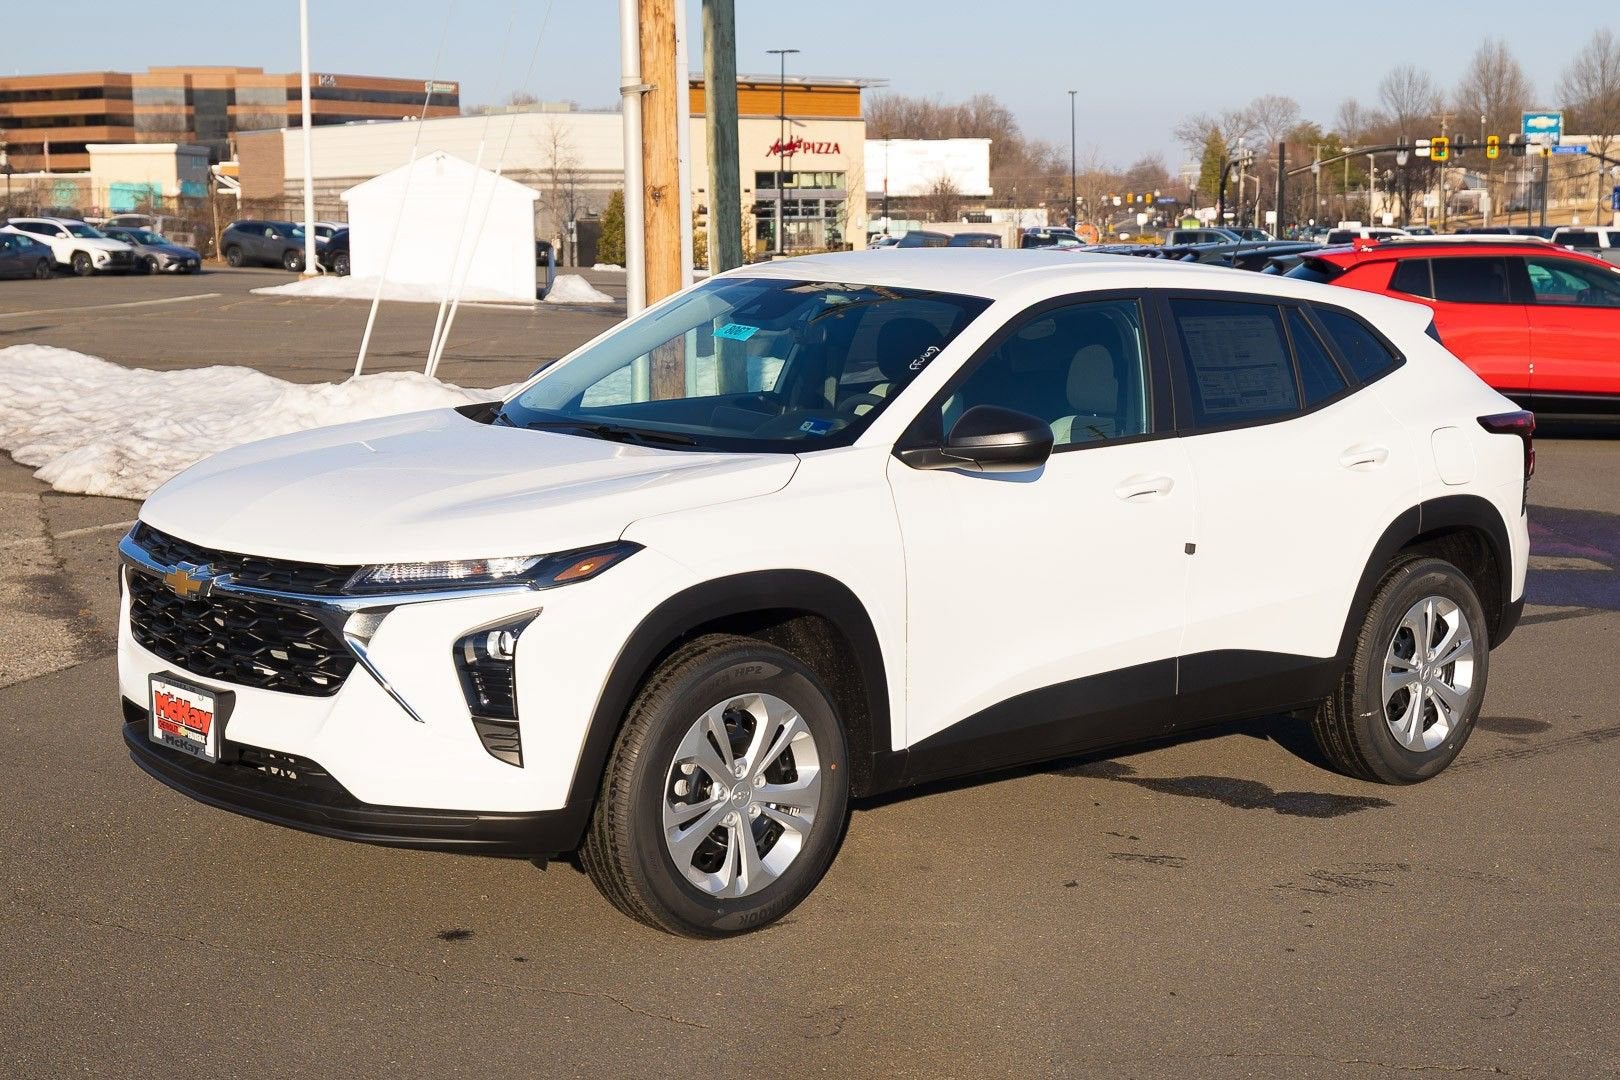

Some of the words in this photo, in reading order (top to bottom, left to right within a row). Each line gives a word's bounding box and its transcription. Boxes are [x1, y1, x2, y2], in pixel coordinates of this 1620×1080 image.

[803, 142, 840, 154] PIZZA
[154, 690, 213, 736] McKay
[165, 733, 201, 755] McKay
